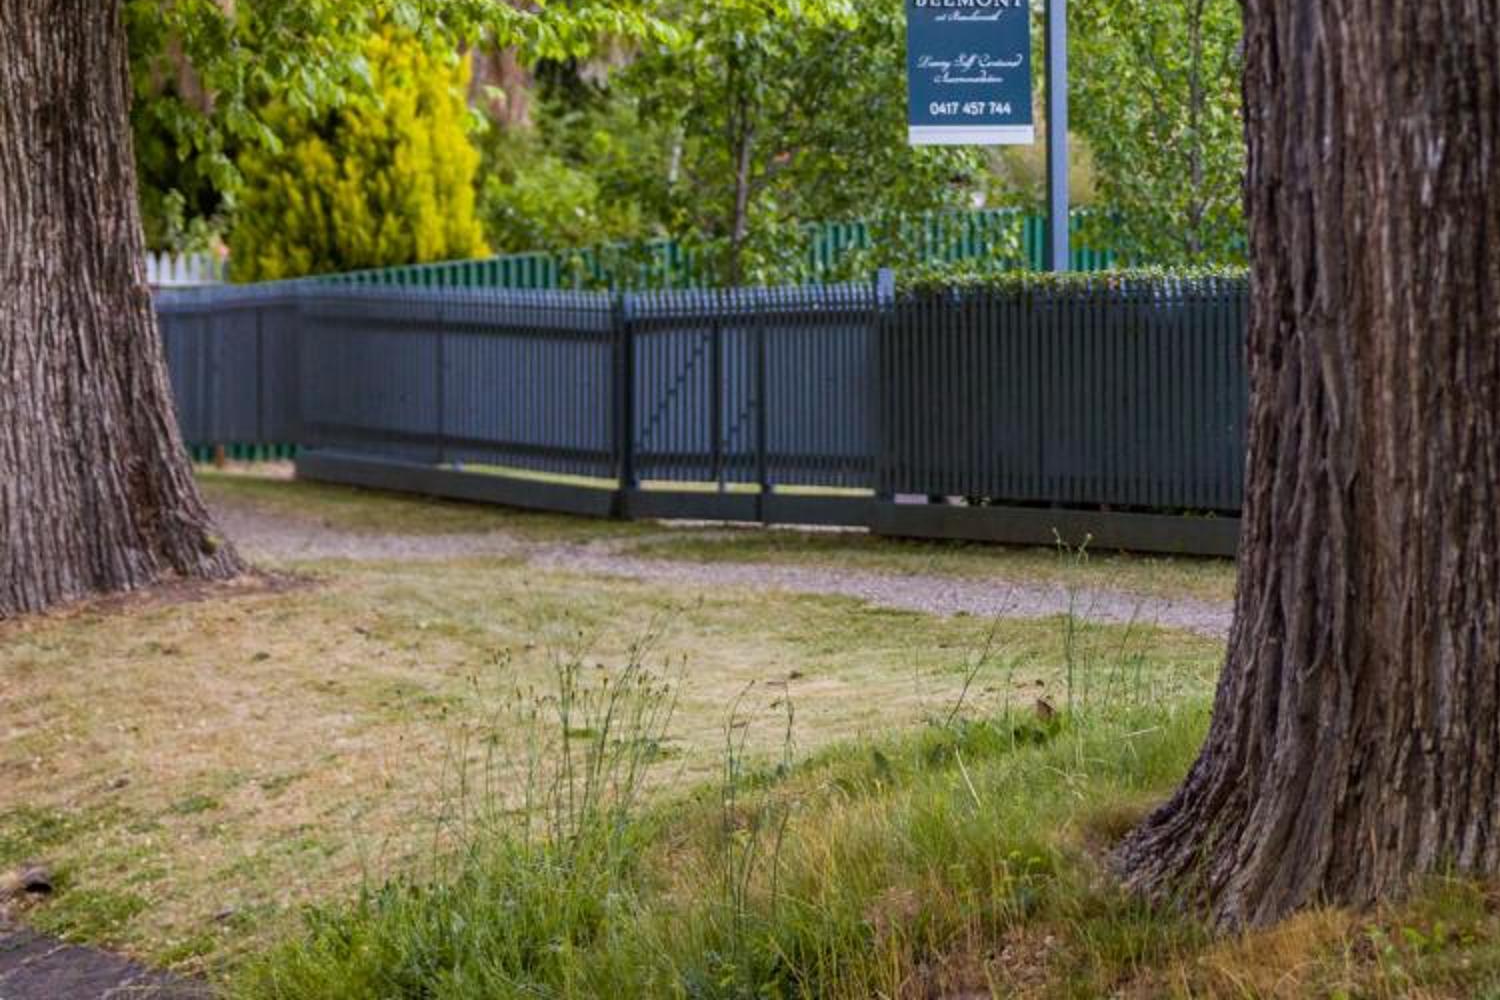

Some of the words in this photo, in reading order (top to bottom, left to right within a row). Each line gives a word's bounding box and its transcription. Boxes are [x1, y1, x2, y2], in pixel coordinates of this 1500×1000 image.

[929, 101, 959, 116] 0417
[962, 101, 985, 116] 457
[989, 101, 1012, 116] 744
